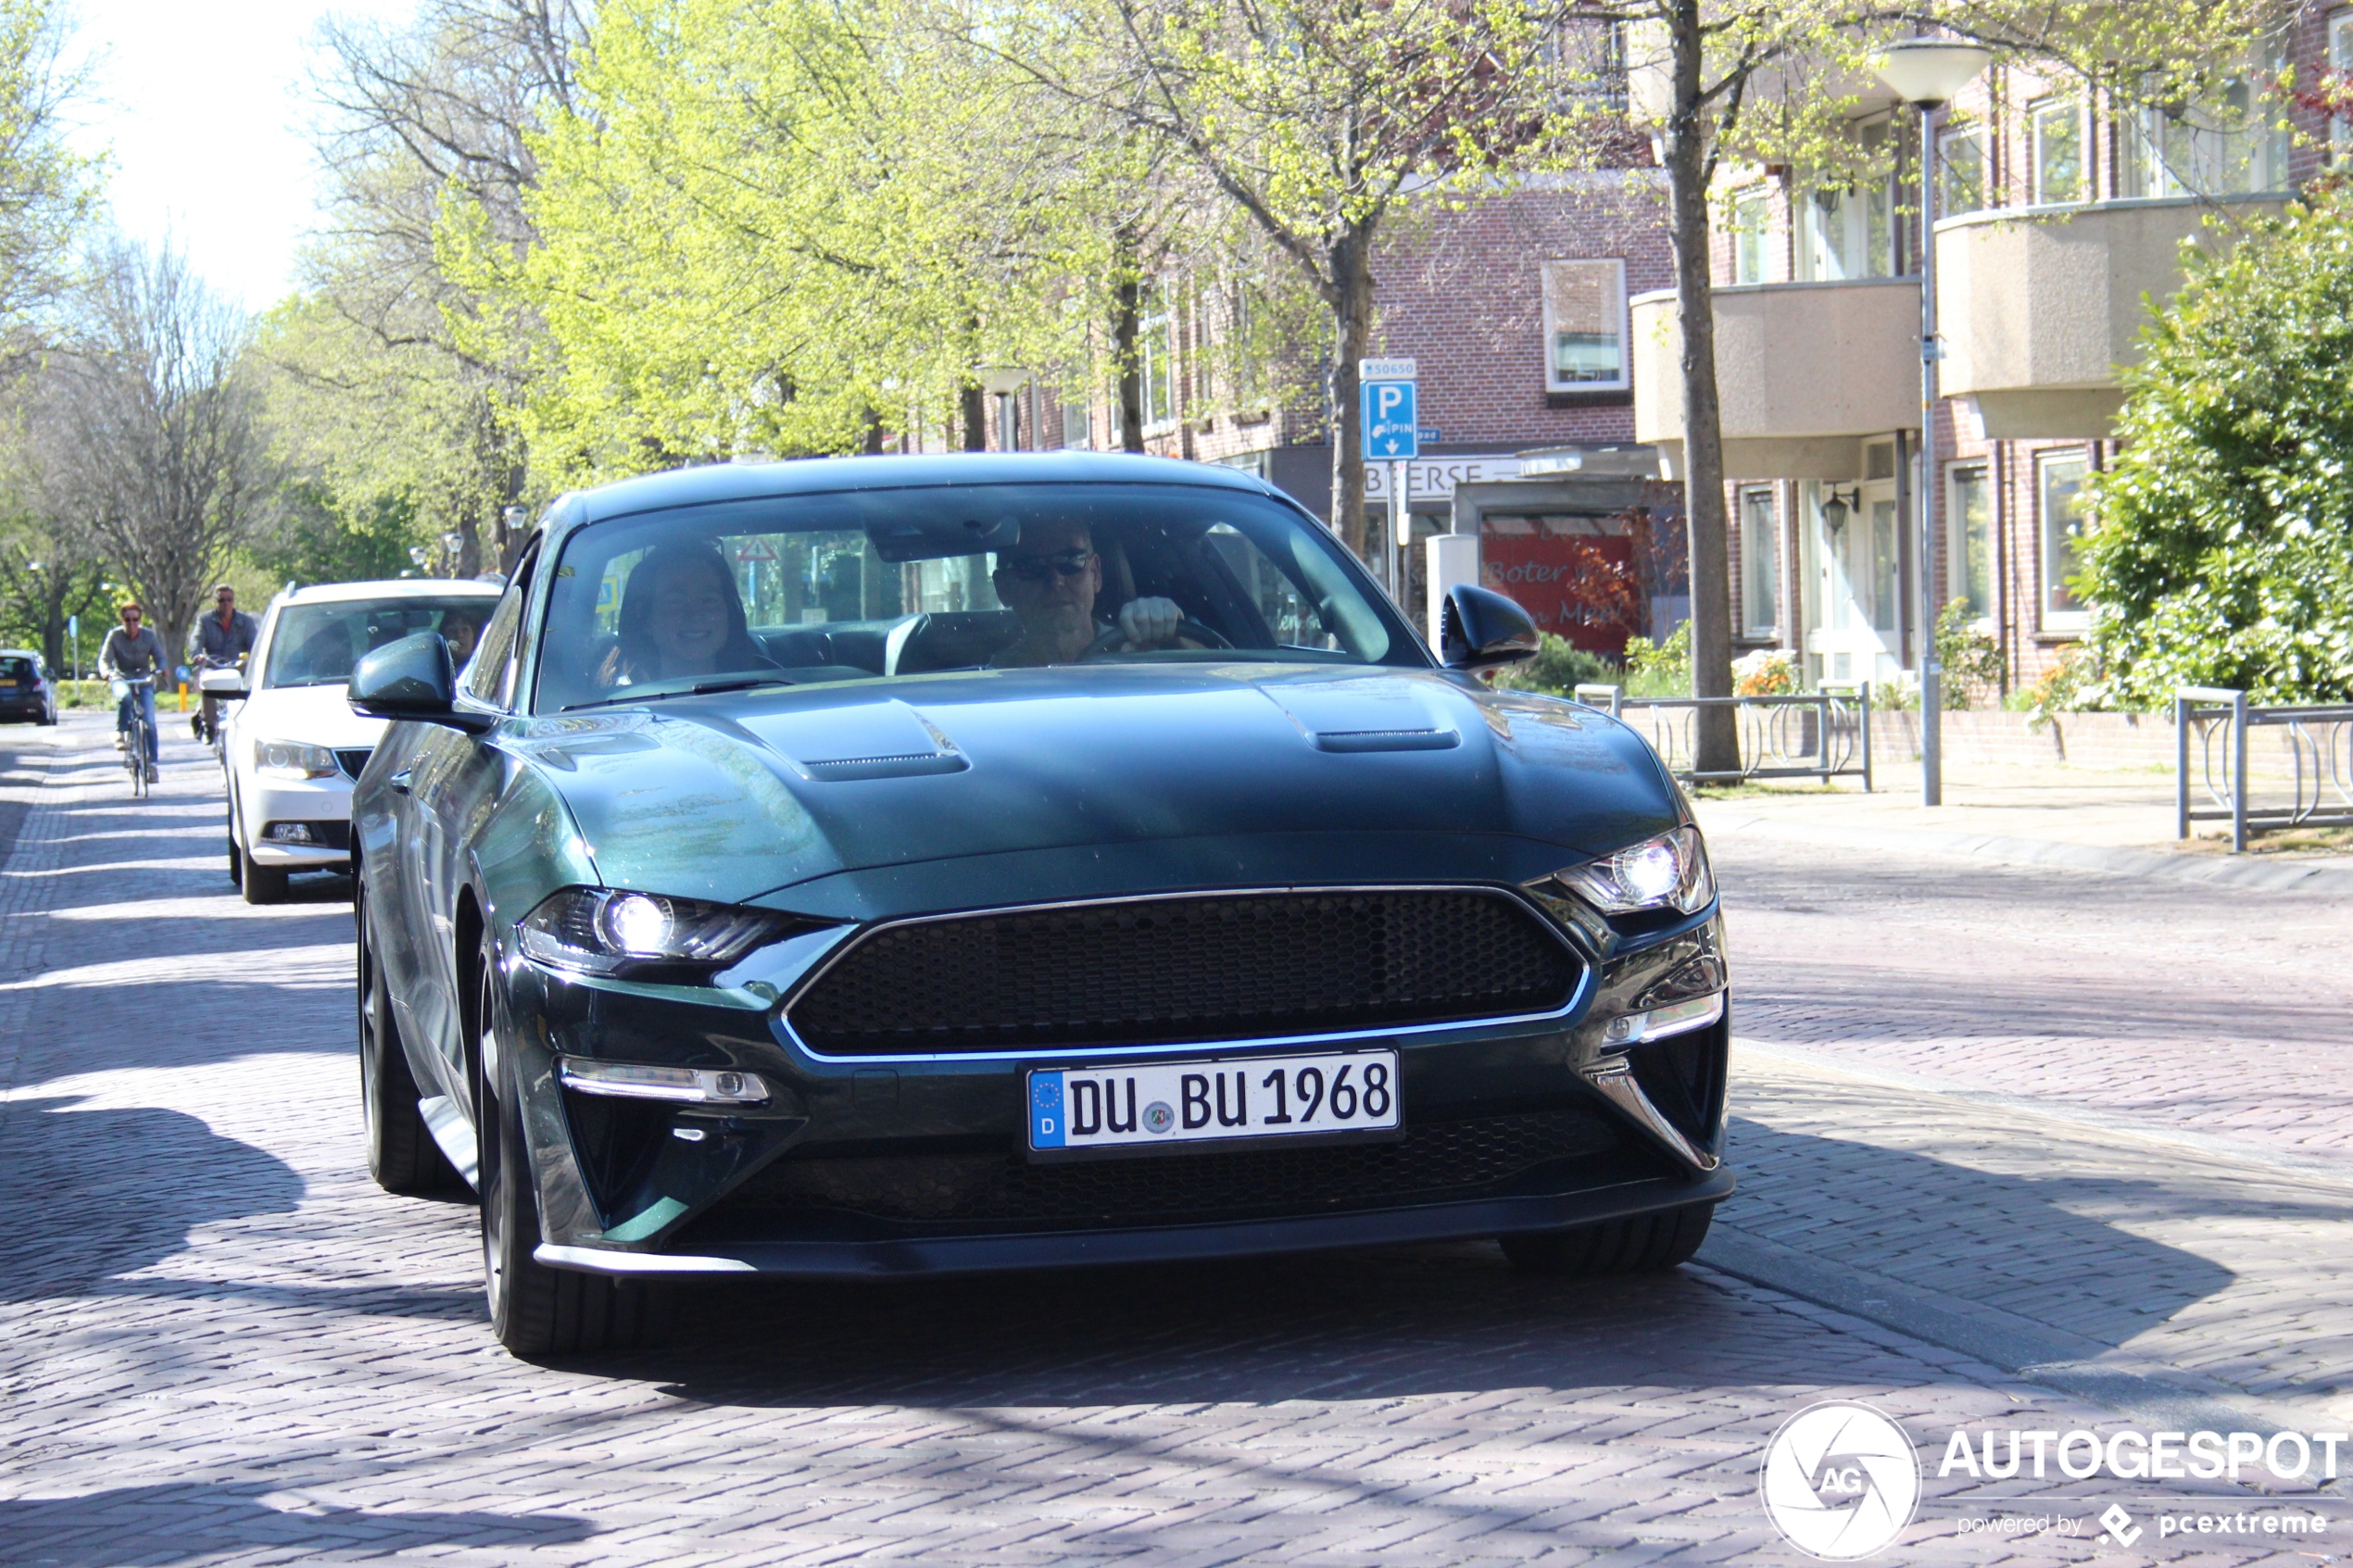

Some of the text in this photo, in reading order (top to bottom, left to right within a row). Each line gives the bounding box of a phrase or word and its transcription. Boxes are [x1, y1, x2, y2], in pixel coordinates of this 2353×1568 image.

[1374, 364, 1414, 375] 50650
[1378, 386, 1403, 420] P
[1391, 423, 1414, 434] PIN
[1365, 465, 1482, 492] BERSE
[1487, 560, 1568, 583] Boter
[1070, 1076, 1138, 1135] DU
[1180, 1071, 1248, 1130] BU
[1262, 1062, 1390, 1124] 1968
[1041, 1118, 1055, 1135] D
